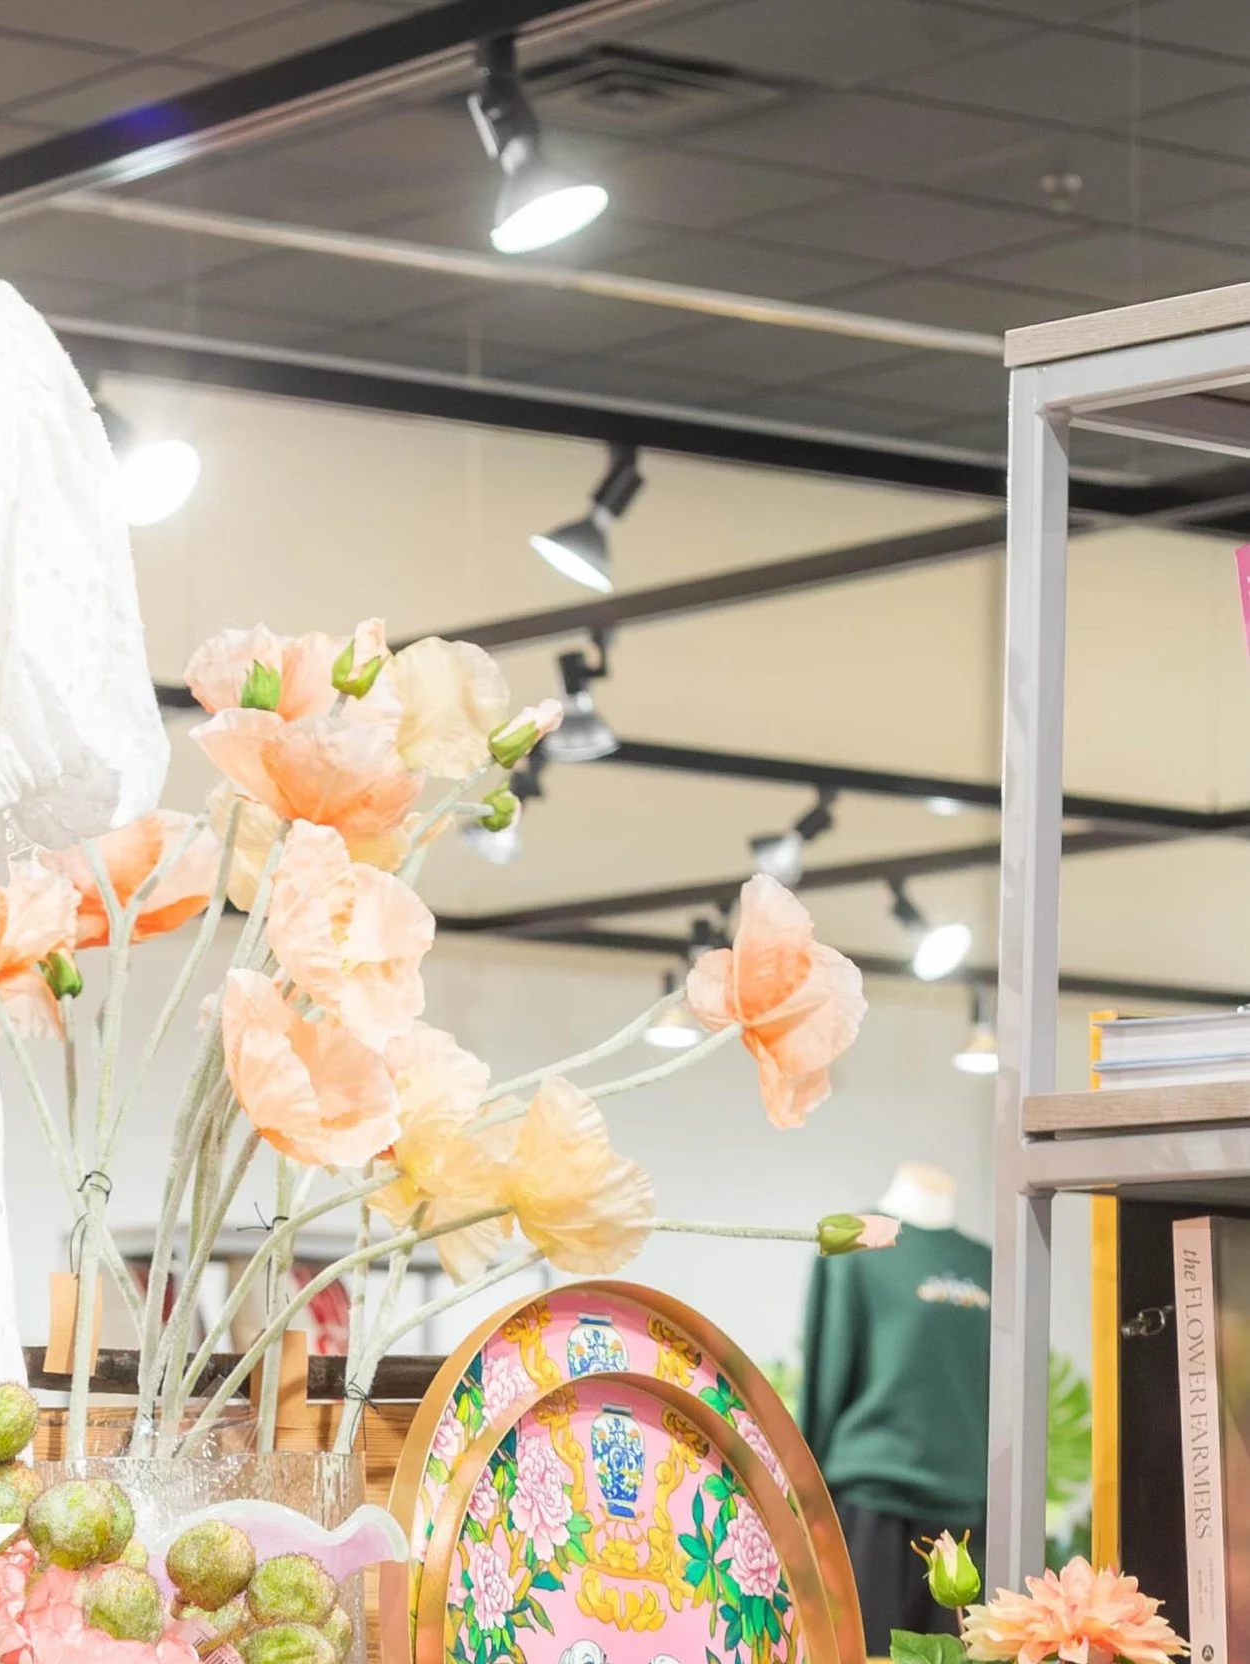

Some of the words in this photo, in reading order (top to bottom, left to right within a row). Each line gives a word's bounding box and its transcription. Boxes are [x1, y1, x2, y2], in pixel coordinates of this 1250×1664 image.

[1183, 1248, 1201, 1280] the
[1185, 1286, 1207, 1406] FLOWER
[1190, 1411, 1213, 1540] FARMERS
